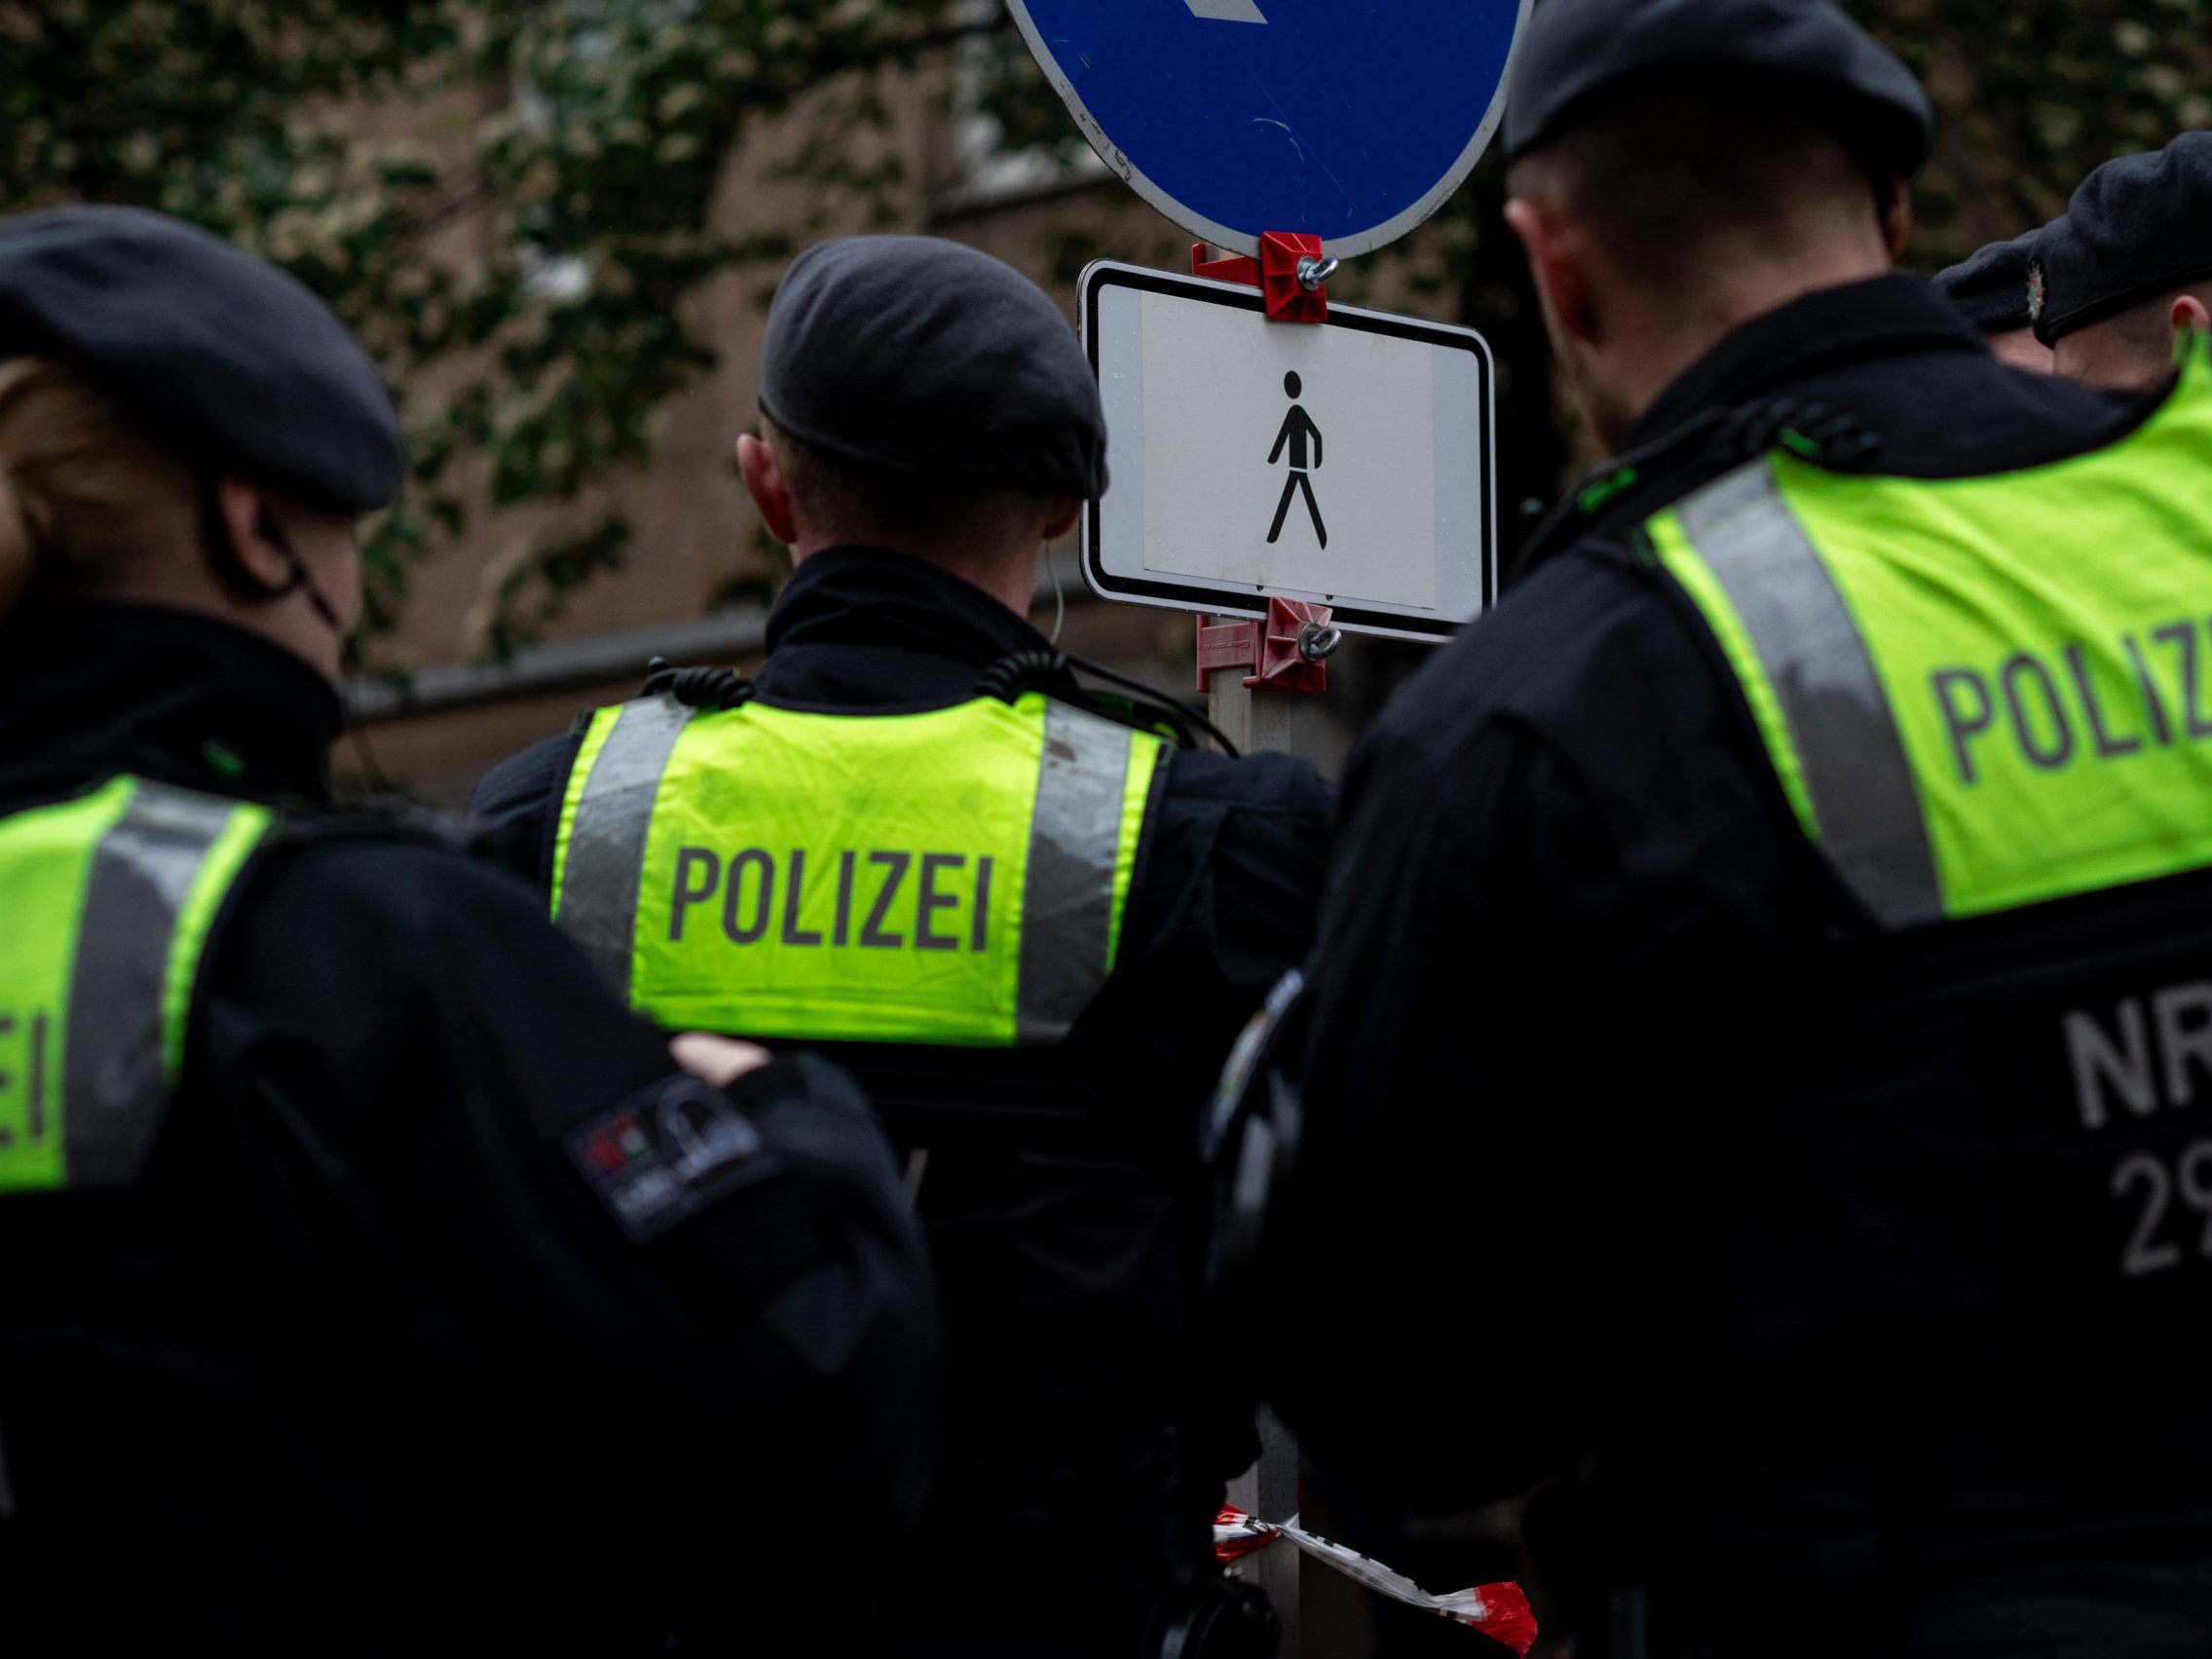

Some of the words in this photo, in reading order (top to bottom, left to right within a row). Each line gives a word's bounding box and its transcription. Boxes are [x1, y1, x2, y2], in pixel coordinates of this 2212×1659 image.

[1931, 617, 2212, 783] POLIZ
[668, 847, 994, 952] POLIZEI
[2064, 980, 2212, 1129] NR
